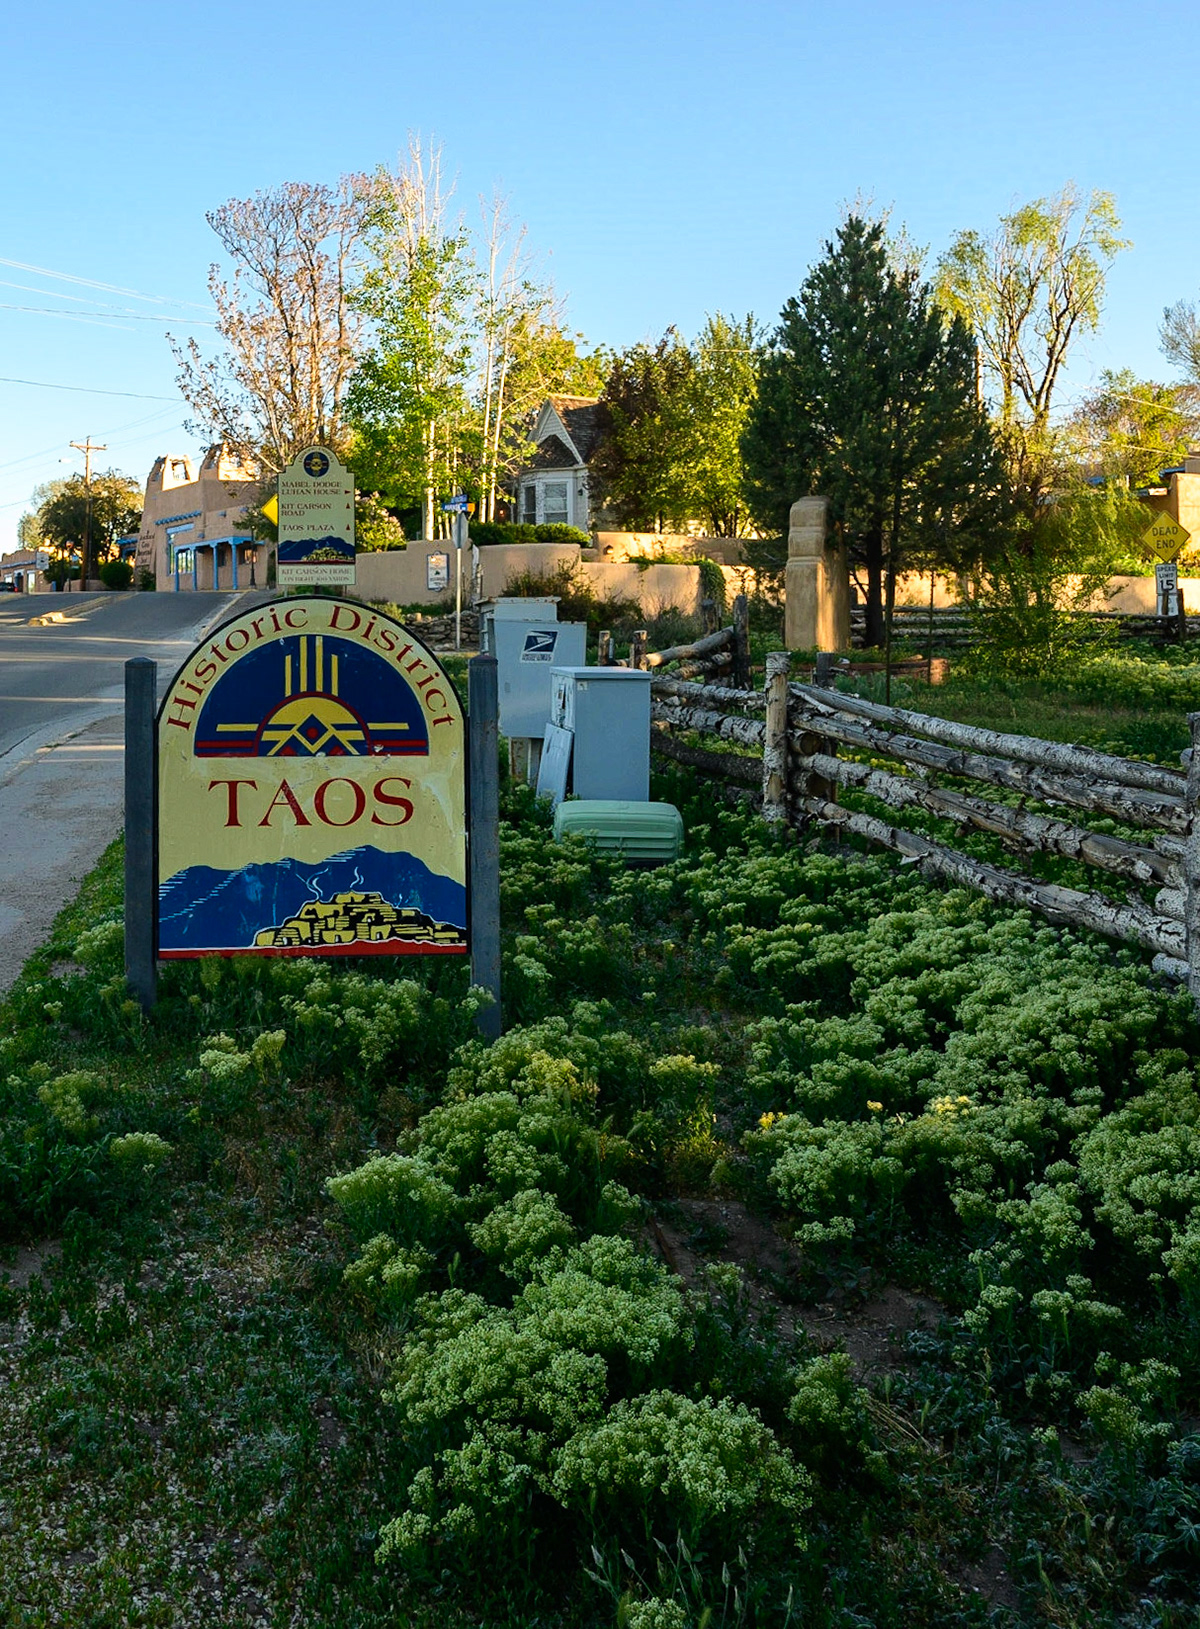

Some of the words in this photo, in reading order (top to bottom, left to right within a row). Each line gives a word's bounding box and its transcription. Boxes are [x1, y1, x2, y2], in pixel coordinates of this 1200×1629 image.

[1152, 526, 1179, 537] DEAD
[1156, 540, 1176, 549] END
[1160, 580, 1175, 591] 15
[208, 777, 415, 827] TAOS
